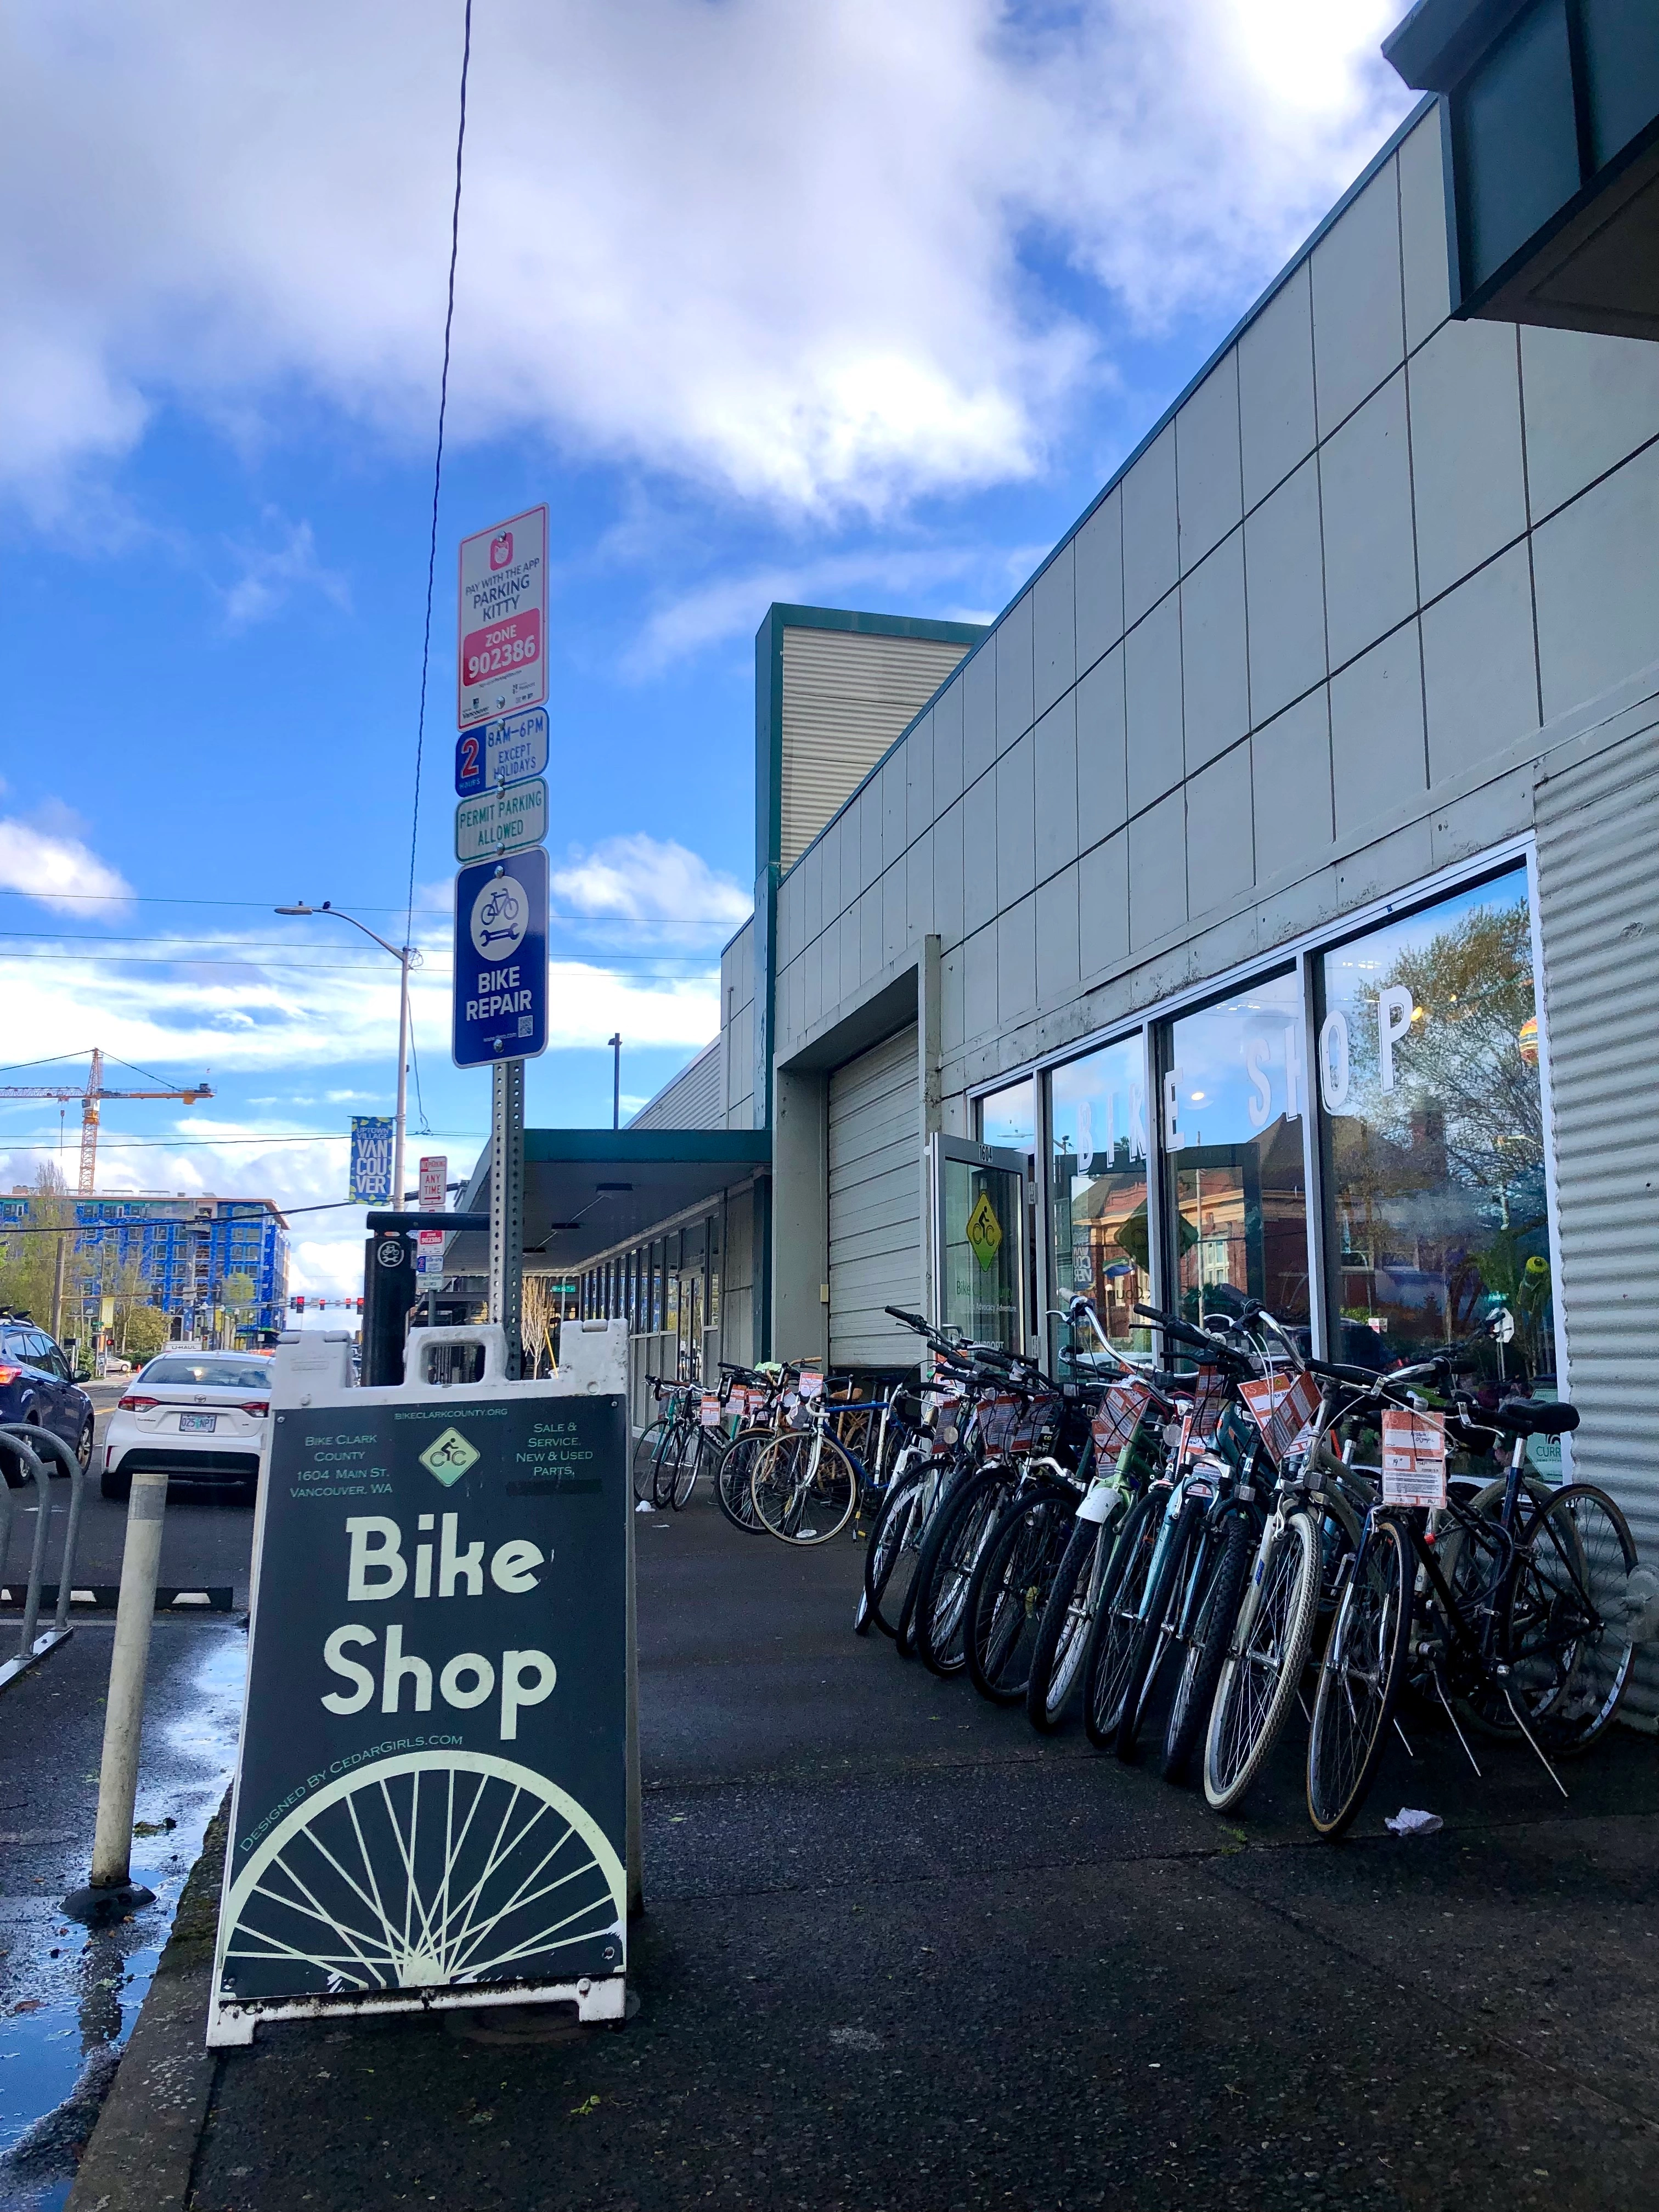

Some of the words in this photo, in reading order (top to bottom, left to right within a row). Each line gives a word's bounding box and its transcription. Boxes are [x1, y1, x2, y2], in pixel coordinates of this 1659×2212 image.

[465, 583, 481, 596] PAY
[482, 573, 504, 589] WITH
[505, 565, 522, 580] THE
[523, 557, 540, 573] APP
[473, 574, 530, 609] PARKING
[483, 594, 521, 622] KITTY
[485, 624, 517, 647] ZONE
[469, 635, 536, 679] 902386
[461, 737, 479, 778] 2
[499, 743, 532, 764] EXCEPT
[494, 756, 537, 780] HOLIDAYS
[460, 804, 495, 830] PERMIT
[499, 791, 542, 818] PARKING
[478, 820, 523, 846] ALLOWED
[478, 966, 521, 994] BIKE
[466, 990, 532, 1022] REPAIR
[357, 1139, 388, 1158] VAN
[979, 1145, 992, 1162] 1604
[357, 1158, 387, 1176] COU
[356, 1175, 386, 1194] VER
[425, 1174, 441, 1184] ANY
[424, 1185, 441, 1195] TIME
[956, 1280, 970, 1296] Bike
[394, 1408, 508, 1420] BIKECLARKCOUNTY.ORG
[533, 1423, 565, 1433] SALE
[567, 1422, 577, 1431] &
[305, 1436, 334, 1446] BIKE
[335, 1435, 377, 1444] CLARK
[314, 1452, 366, 1462] COUNTY
[516, 1453, 545, 1462] NEW
[548, 1451, 557, 1461] &
[560, 1451, 593, 1460] USED
[297, 1470, 330, 1481] 1604
[335, 1469, 367, 1479] MAIN
[370, 1468, 390, 1478] ST.
[370, 1483, 393, 1494] WA
[346, 1513, 545, 1601] Bike
[321, 1624, 557, 1740] Shop
[240, 1786, 307, 1852] DESIGNED
[307, 1770, 327, 1788] BY
[330, 1735, 464, 1774] CEDARGIRLS.COM
